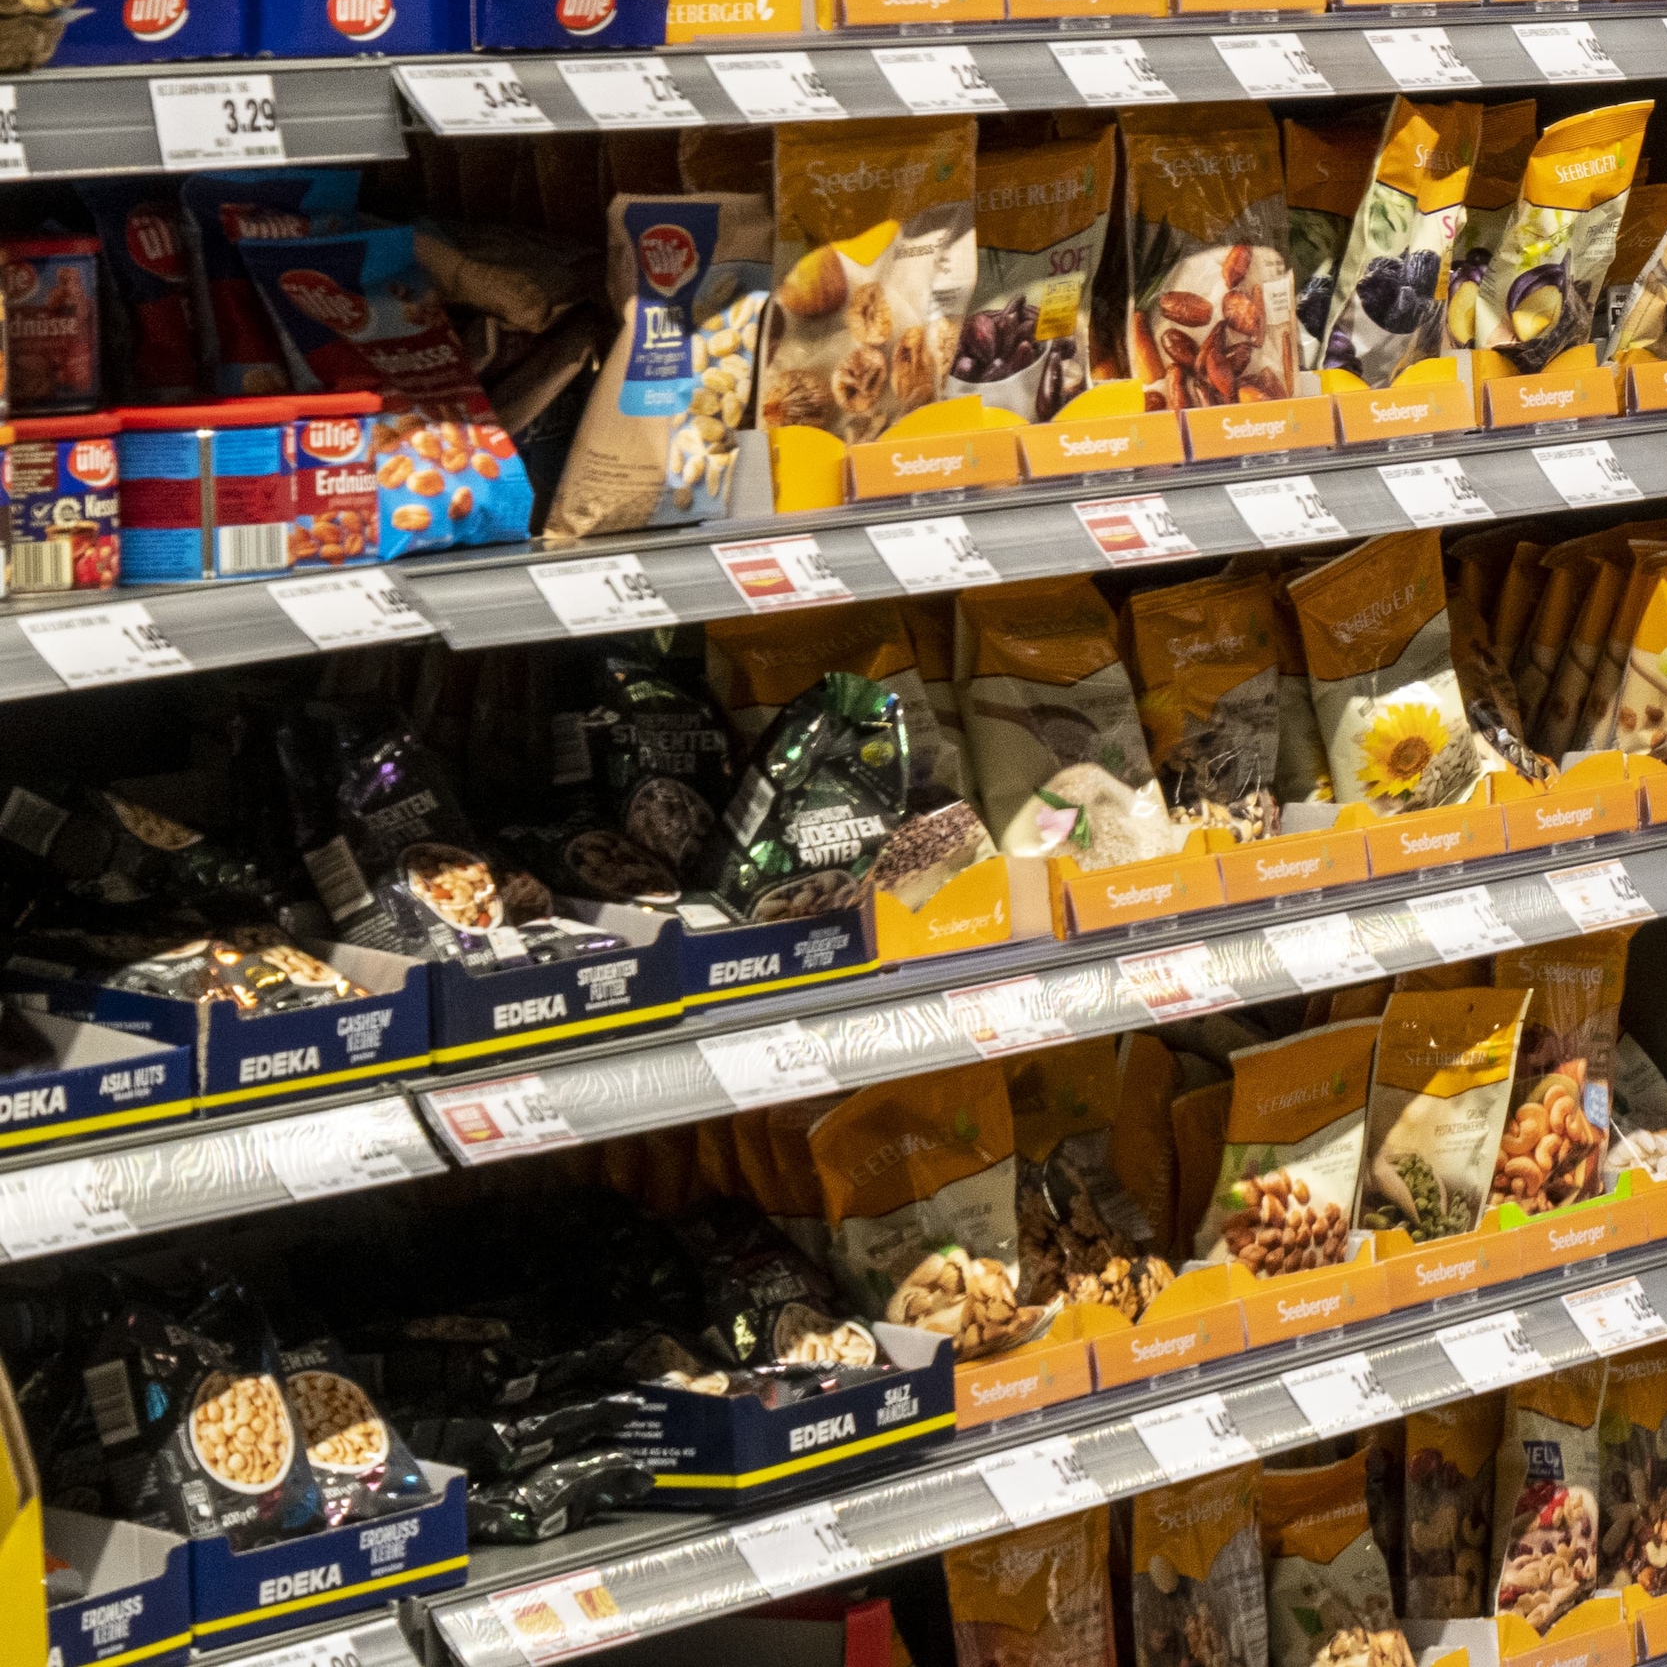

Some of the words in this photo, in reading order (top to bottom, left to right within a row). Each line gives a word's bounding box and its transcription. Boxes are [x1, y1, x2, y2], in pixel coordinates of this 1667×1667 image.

[224, 100, 276, 133] 3.29
[1556, 156, 1617, 183] SEEBERGER
[1371, 402, 1429, 422] Seeberger
[1519, 388, 1575, 408] Seeberger
[309, 425, 360, 453] ültje
[1222, 417, 1287, 438] Seeberger
[1059, 431, 1130, 455] Seeberger
[893, 457, 963, 475] Seeberger
[1536, 807, 1594, 830] Seeberger
[1401, 830, 1460, 853] Seeberger
[1256, 858, 1320, 881] Seeberger
[1107, 881, 1173, 905] Seeberger
[928, 914, 994, 937] Seeberger
[578, 959, 637, 985] STUDENTEN
[710, 955, 780, 984] EDEKA
[338, 1012, 392, 1038] CASHEW
[494, 994, 566, 1028] EDEKA
[240, 1047, 319, 1082] EDEKA
[100, 1069, 130, 1094] ASIA
[134, 1064, 165, 1087] NUTS
[0, 1086, 65, 1122] DEKA
[501, 1096, 558, 1124] 1.69
[1548, 1225, 1605, 1253] Seeberger
[1416, 1258, 1478, 1287] Seeberger
[1277, 1292, 1341, 1322] Seeberger
[1131, 1334, 1197, 1362] Seeberger
[884, 1383, 909, 1404] SALZ
[970, 1373, 1038, 1404] Seeberger
[792, 1415, 855, 1450] EDEKA
[260, 1565, 341, 1604] EDEKA
